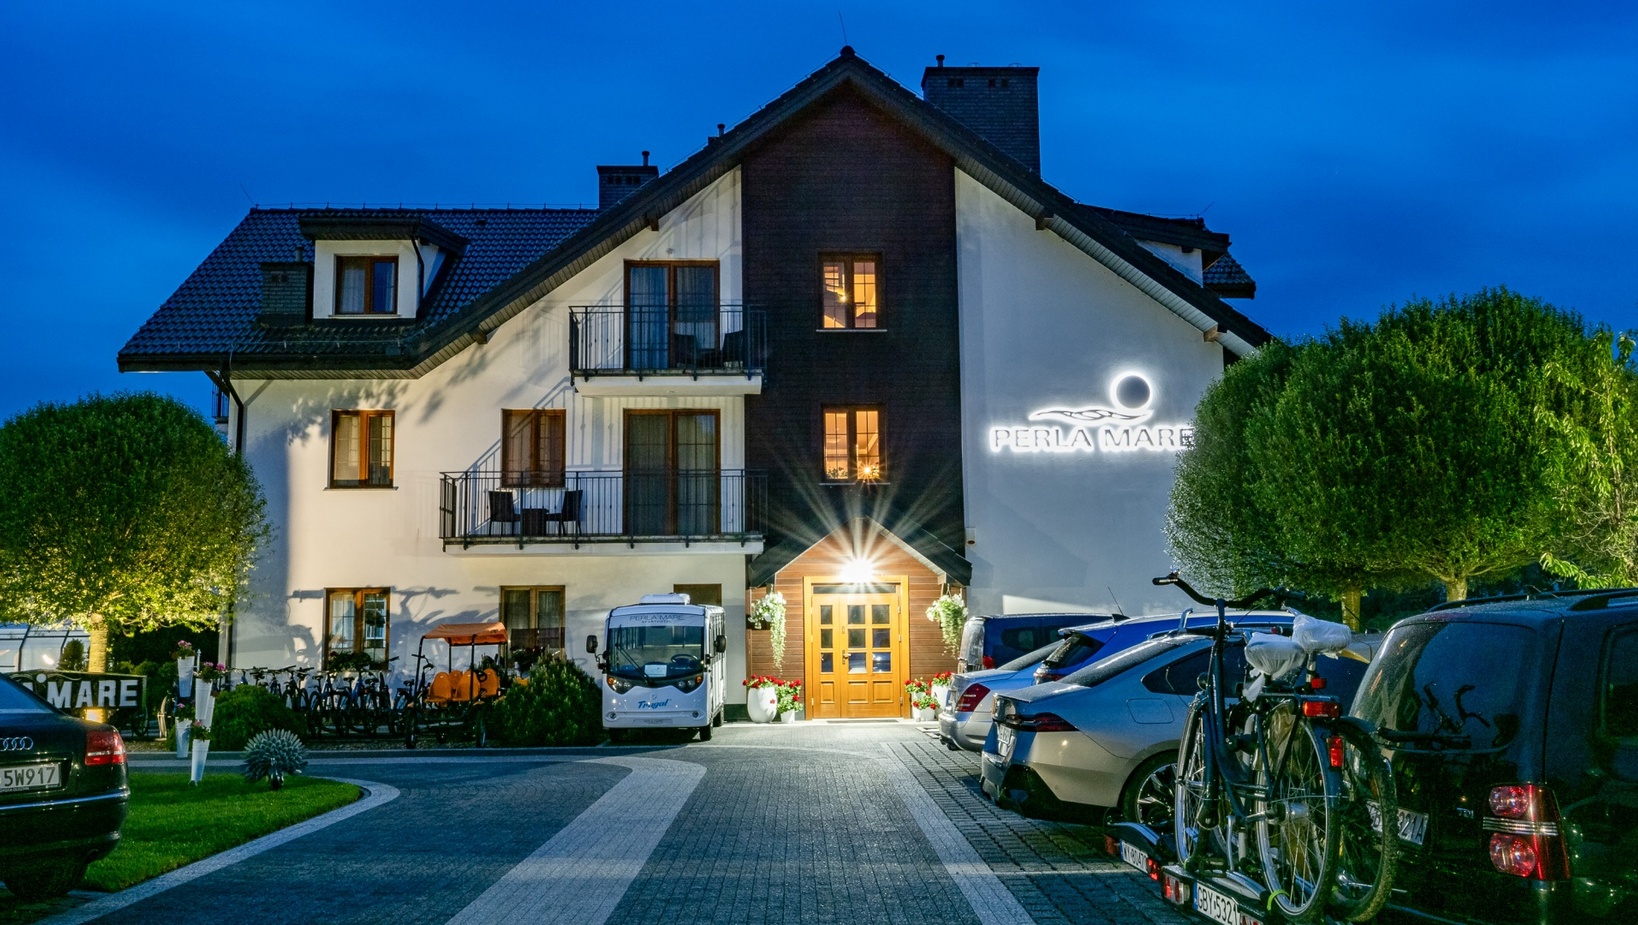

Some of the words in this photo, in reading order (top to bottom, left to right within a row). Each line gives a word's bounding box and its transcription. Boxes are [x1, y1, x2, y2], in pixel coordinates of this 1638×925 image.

[994, 429, 1092, 448] PERLA
[1104, 428, 1195, 448] MARE
[659, 613, 685, 621] MARE
[47, 680, 139, 708] MARE
[4, 767, 56, 787] 5W917
[1198, 886, 1213, 914] GBY
[1215, 895, 1242, 925] 5321
